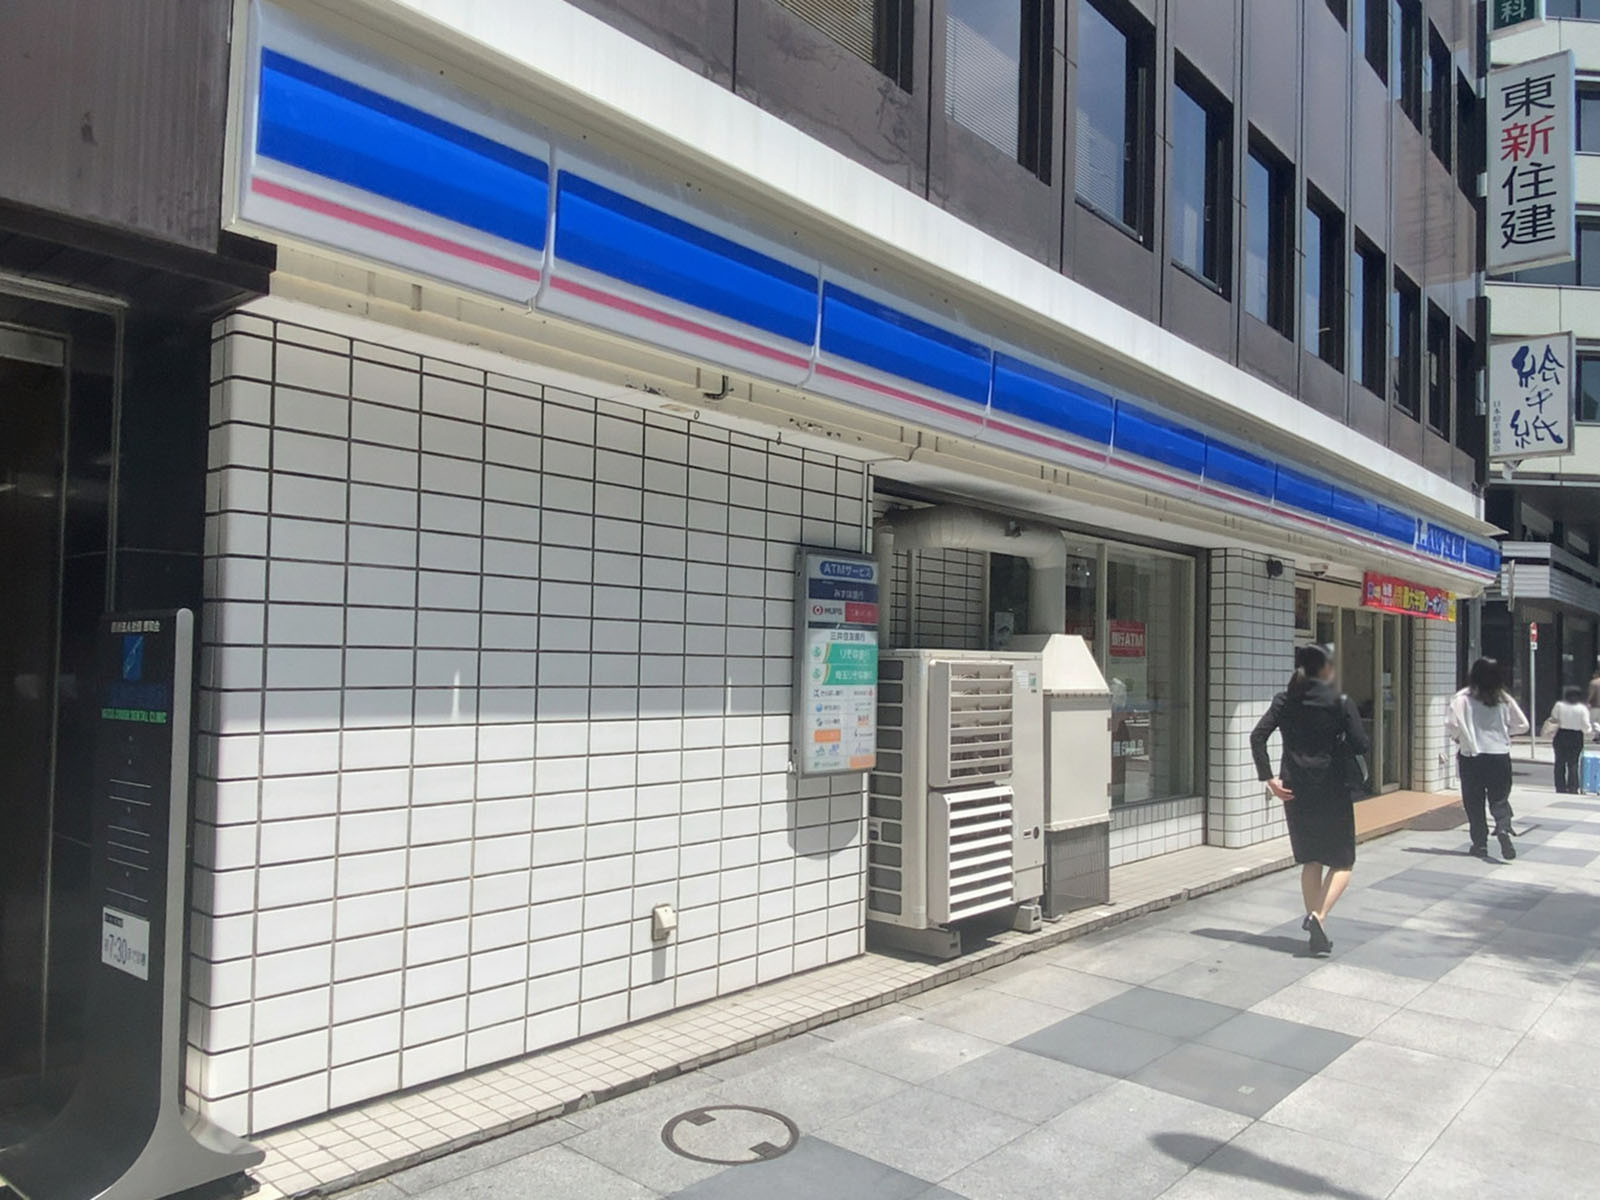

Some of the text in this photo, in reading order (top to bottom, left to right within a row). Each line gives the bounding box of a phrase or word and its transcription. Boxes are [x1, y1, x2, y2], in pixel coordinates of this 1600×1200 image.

[1500, 74, 1557, 249] 東新住建
[823, 563, 872, 578] ATMサービス
